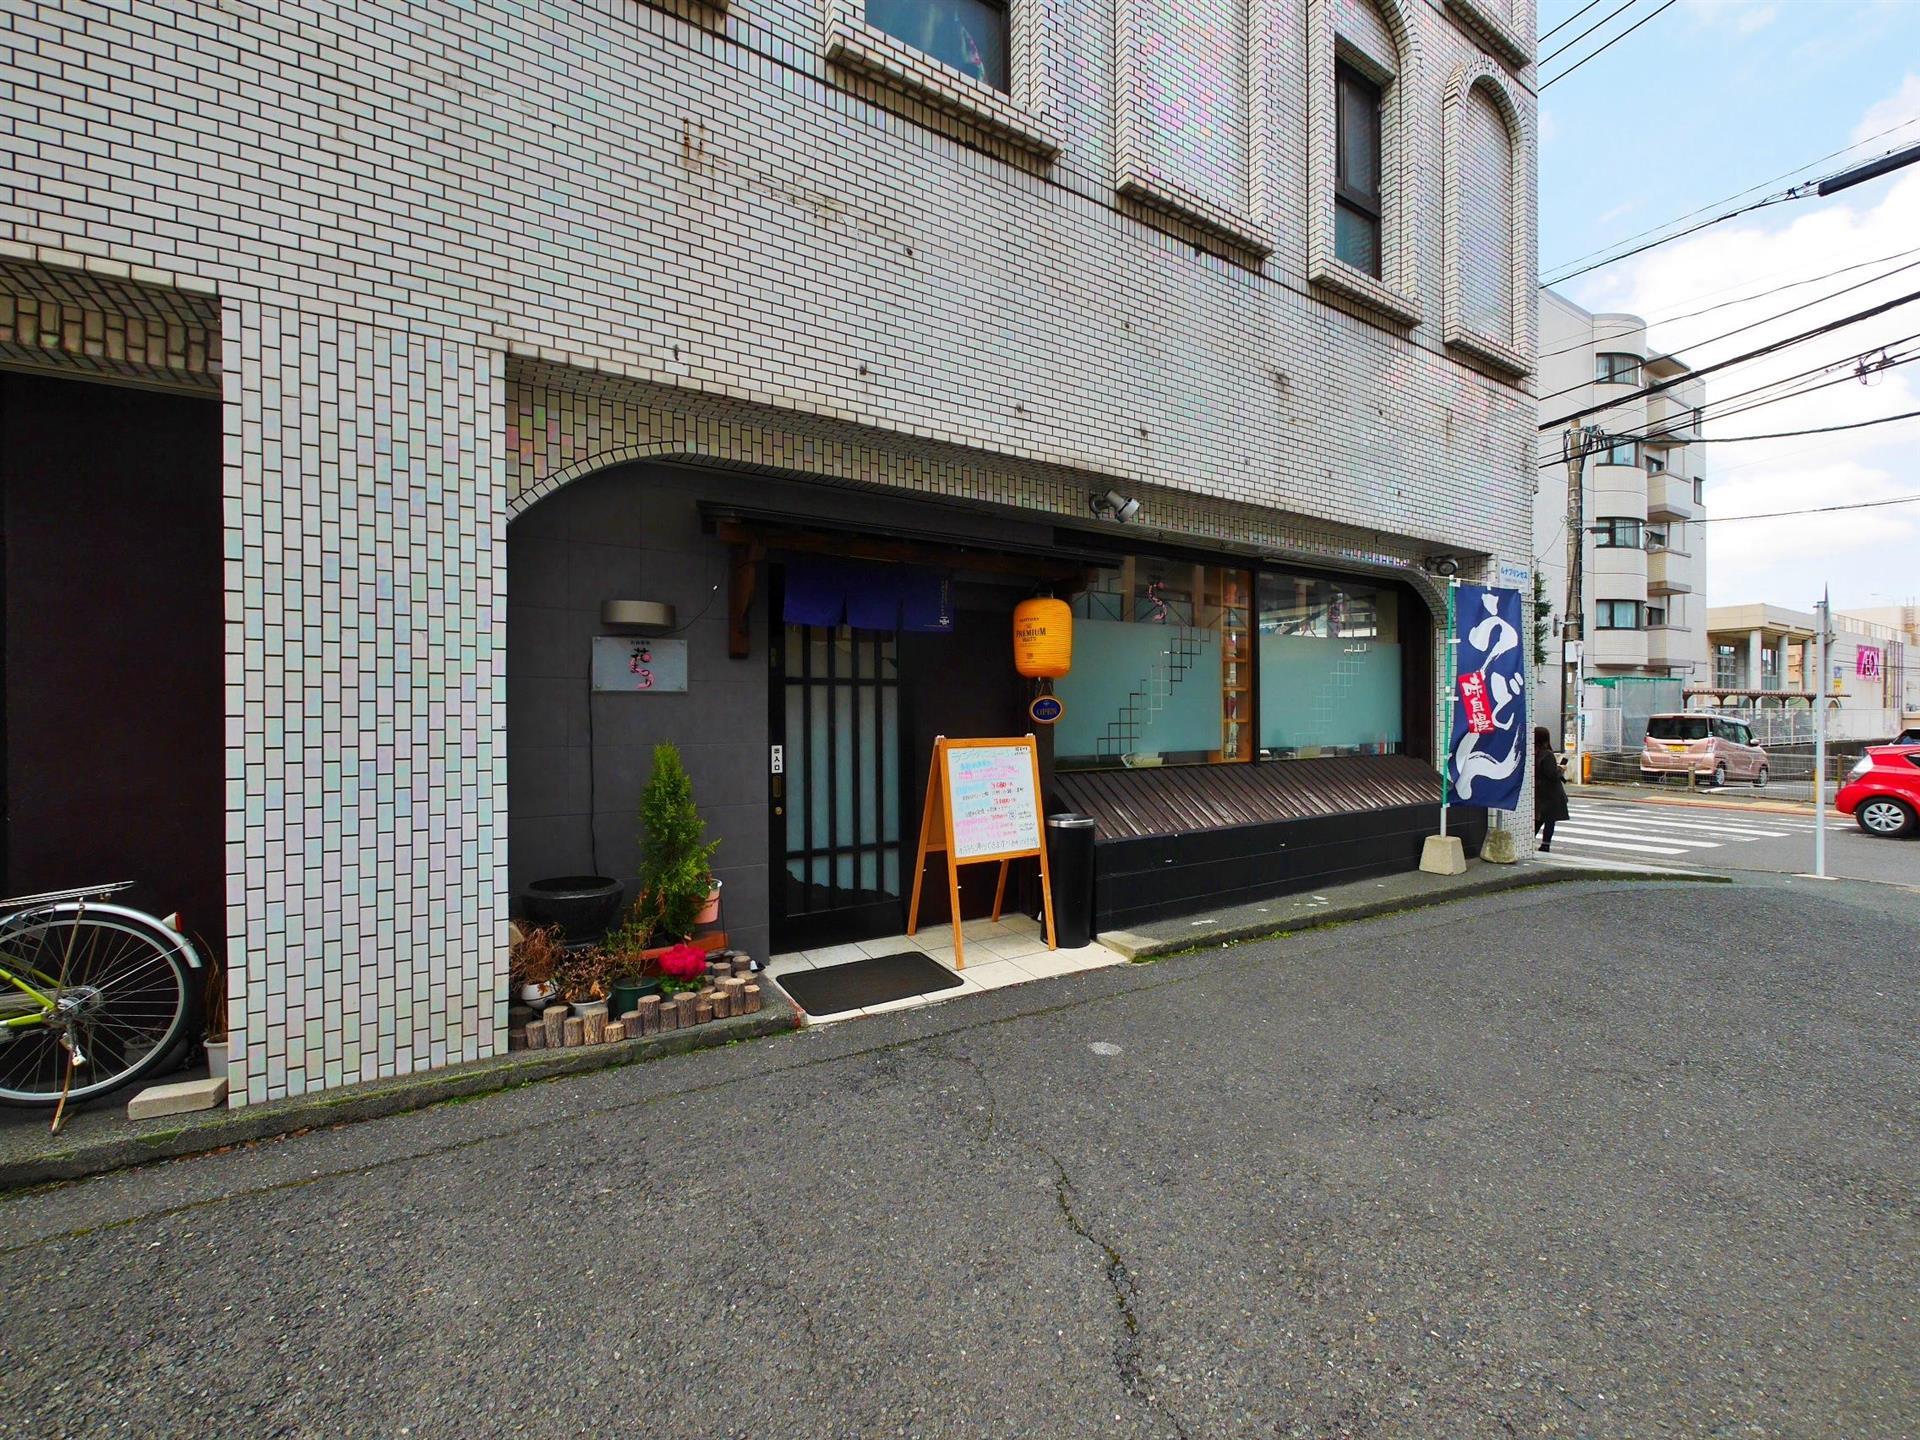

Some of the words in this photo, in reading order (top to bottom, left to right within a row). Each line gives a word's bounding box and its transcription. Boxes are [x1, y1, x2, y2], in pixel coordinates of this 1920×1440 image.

[1016, 627, 1046, 638] PREMIUM
[1455, 593, 1523, 800] うどん
